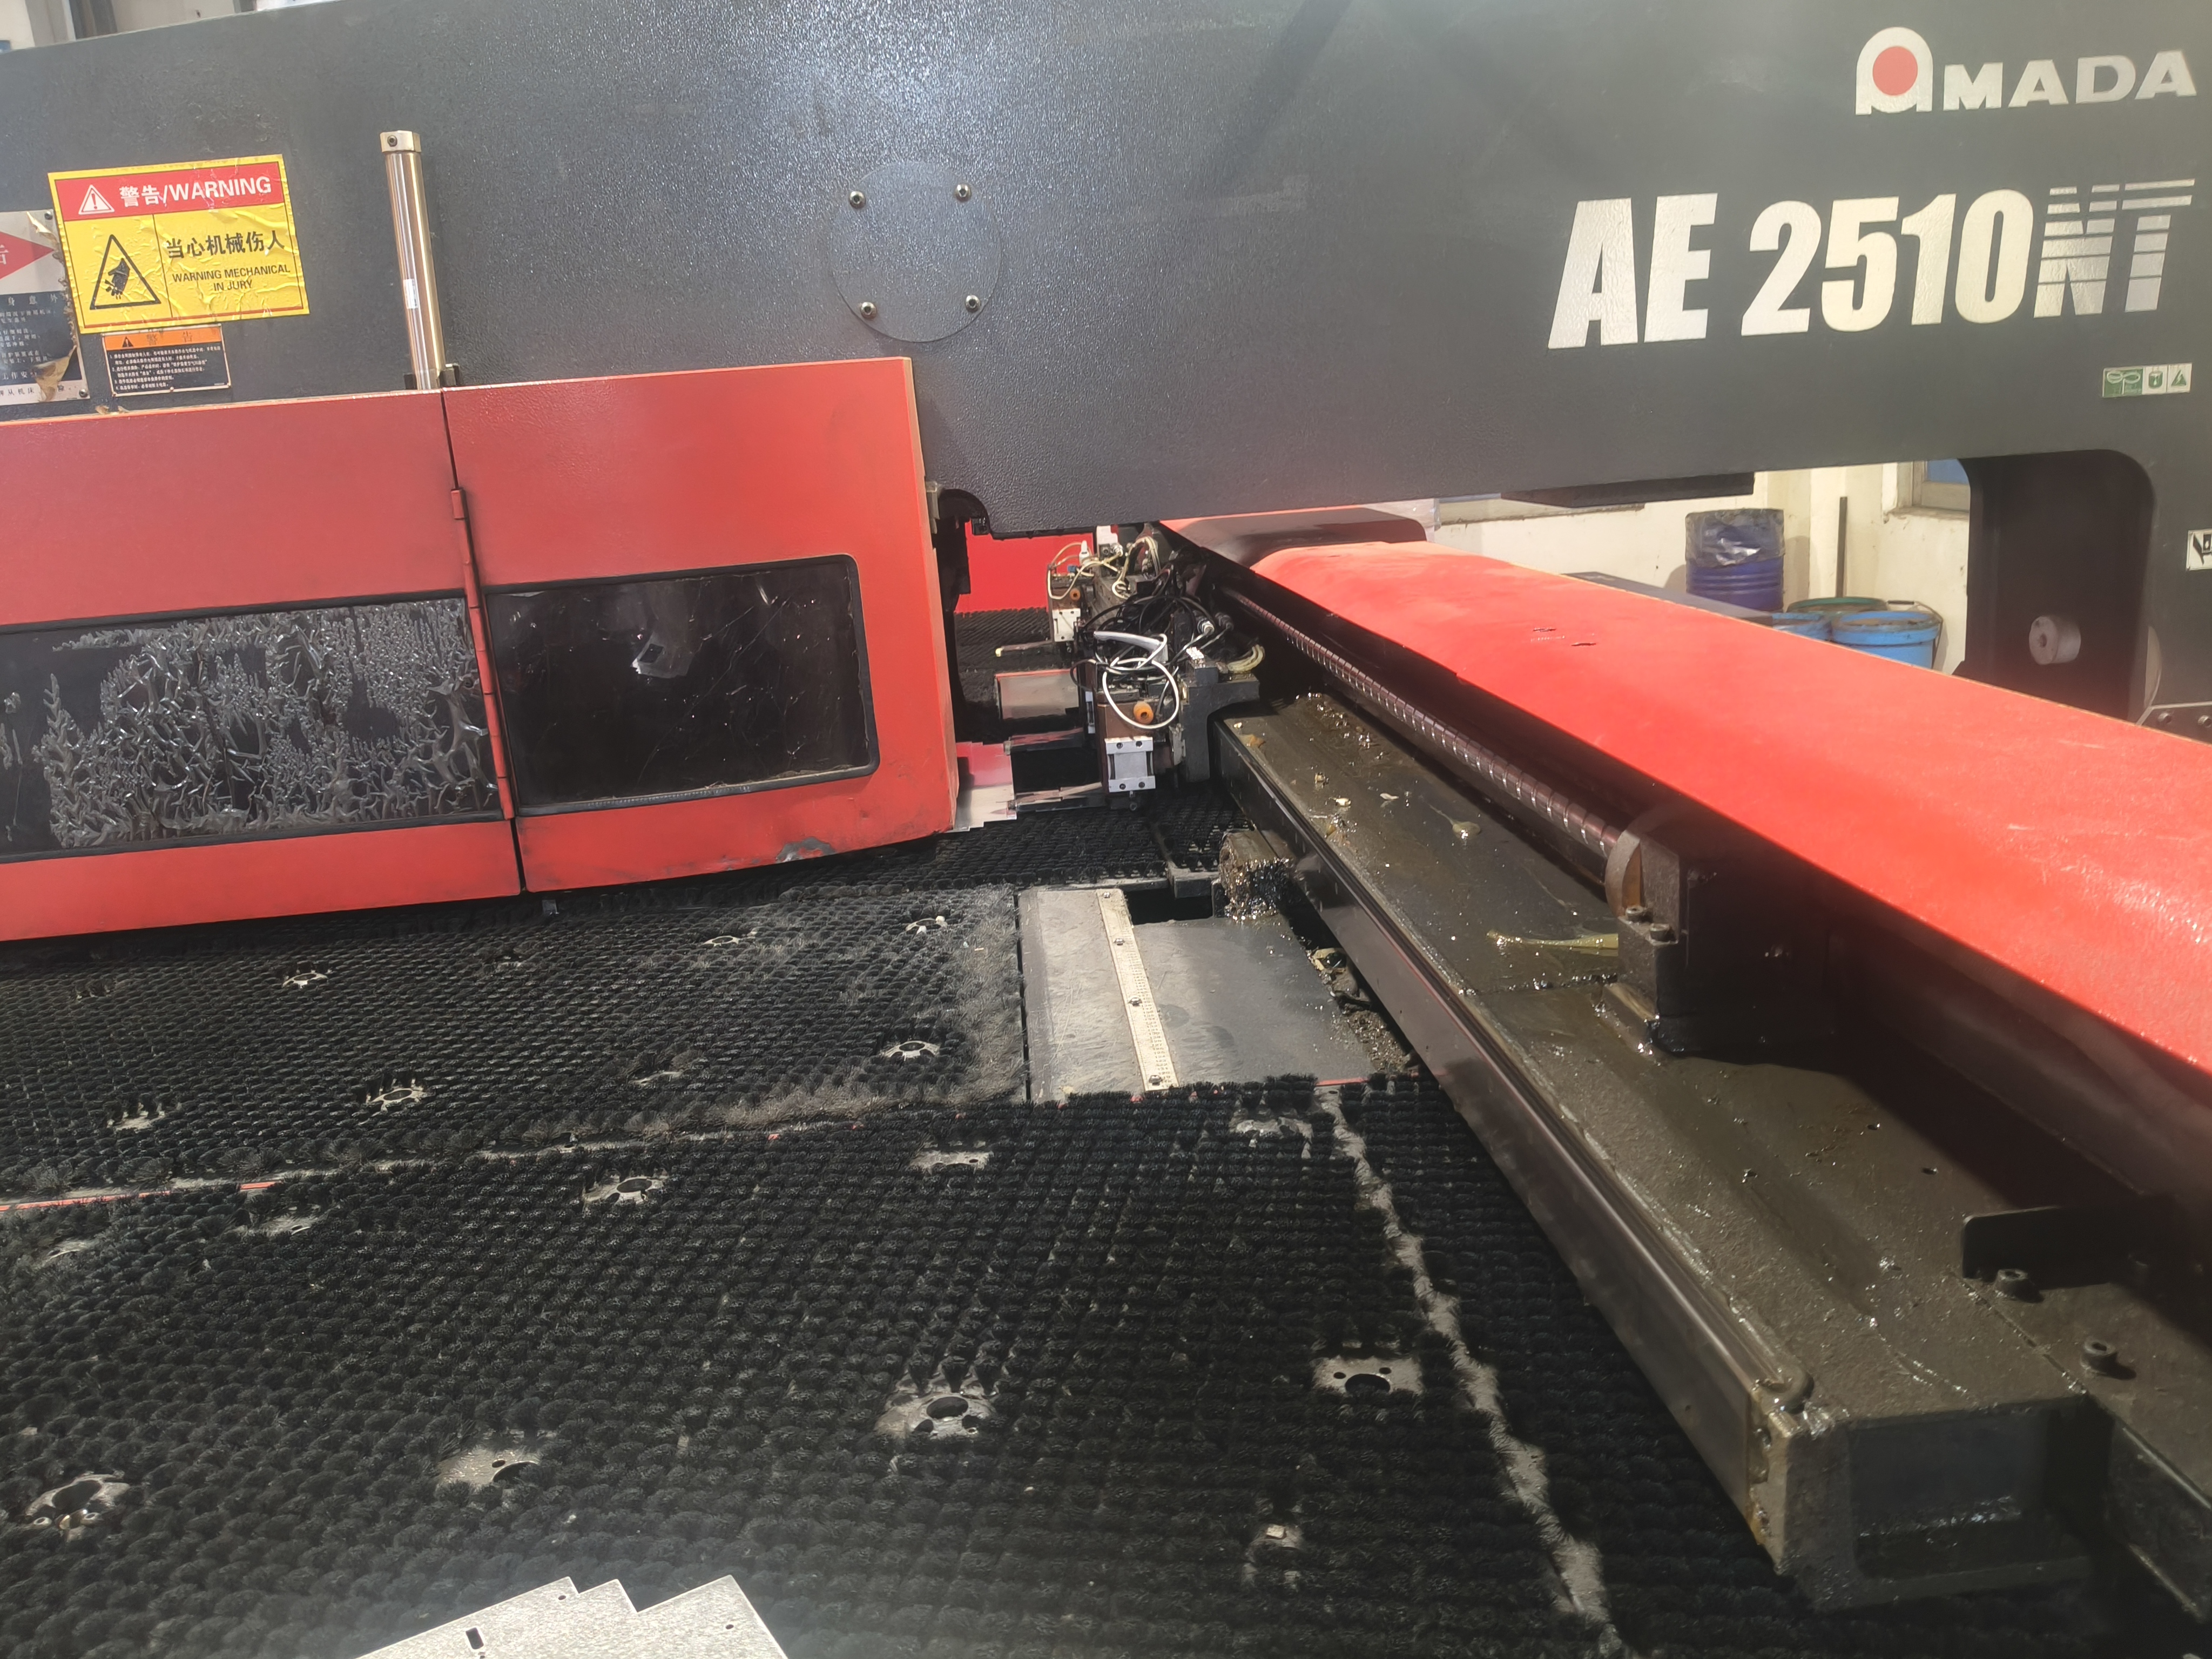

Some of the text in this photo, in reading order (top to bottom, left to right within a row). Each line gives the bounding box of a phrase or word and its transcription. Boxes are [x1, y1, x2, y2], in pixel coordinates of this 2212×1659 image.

[166, 230, 285, 259] 当心机械伤人
[172, 264, 291, 282] WARNING MECHANICAL
[1548, 192, 1718, 349] AE
[213, 279, 253, 292] IN JURY
